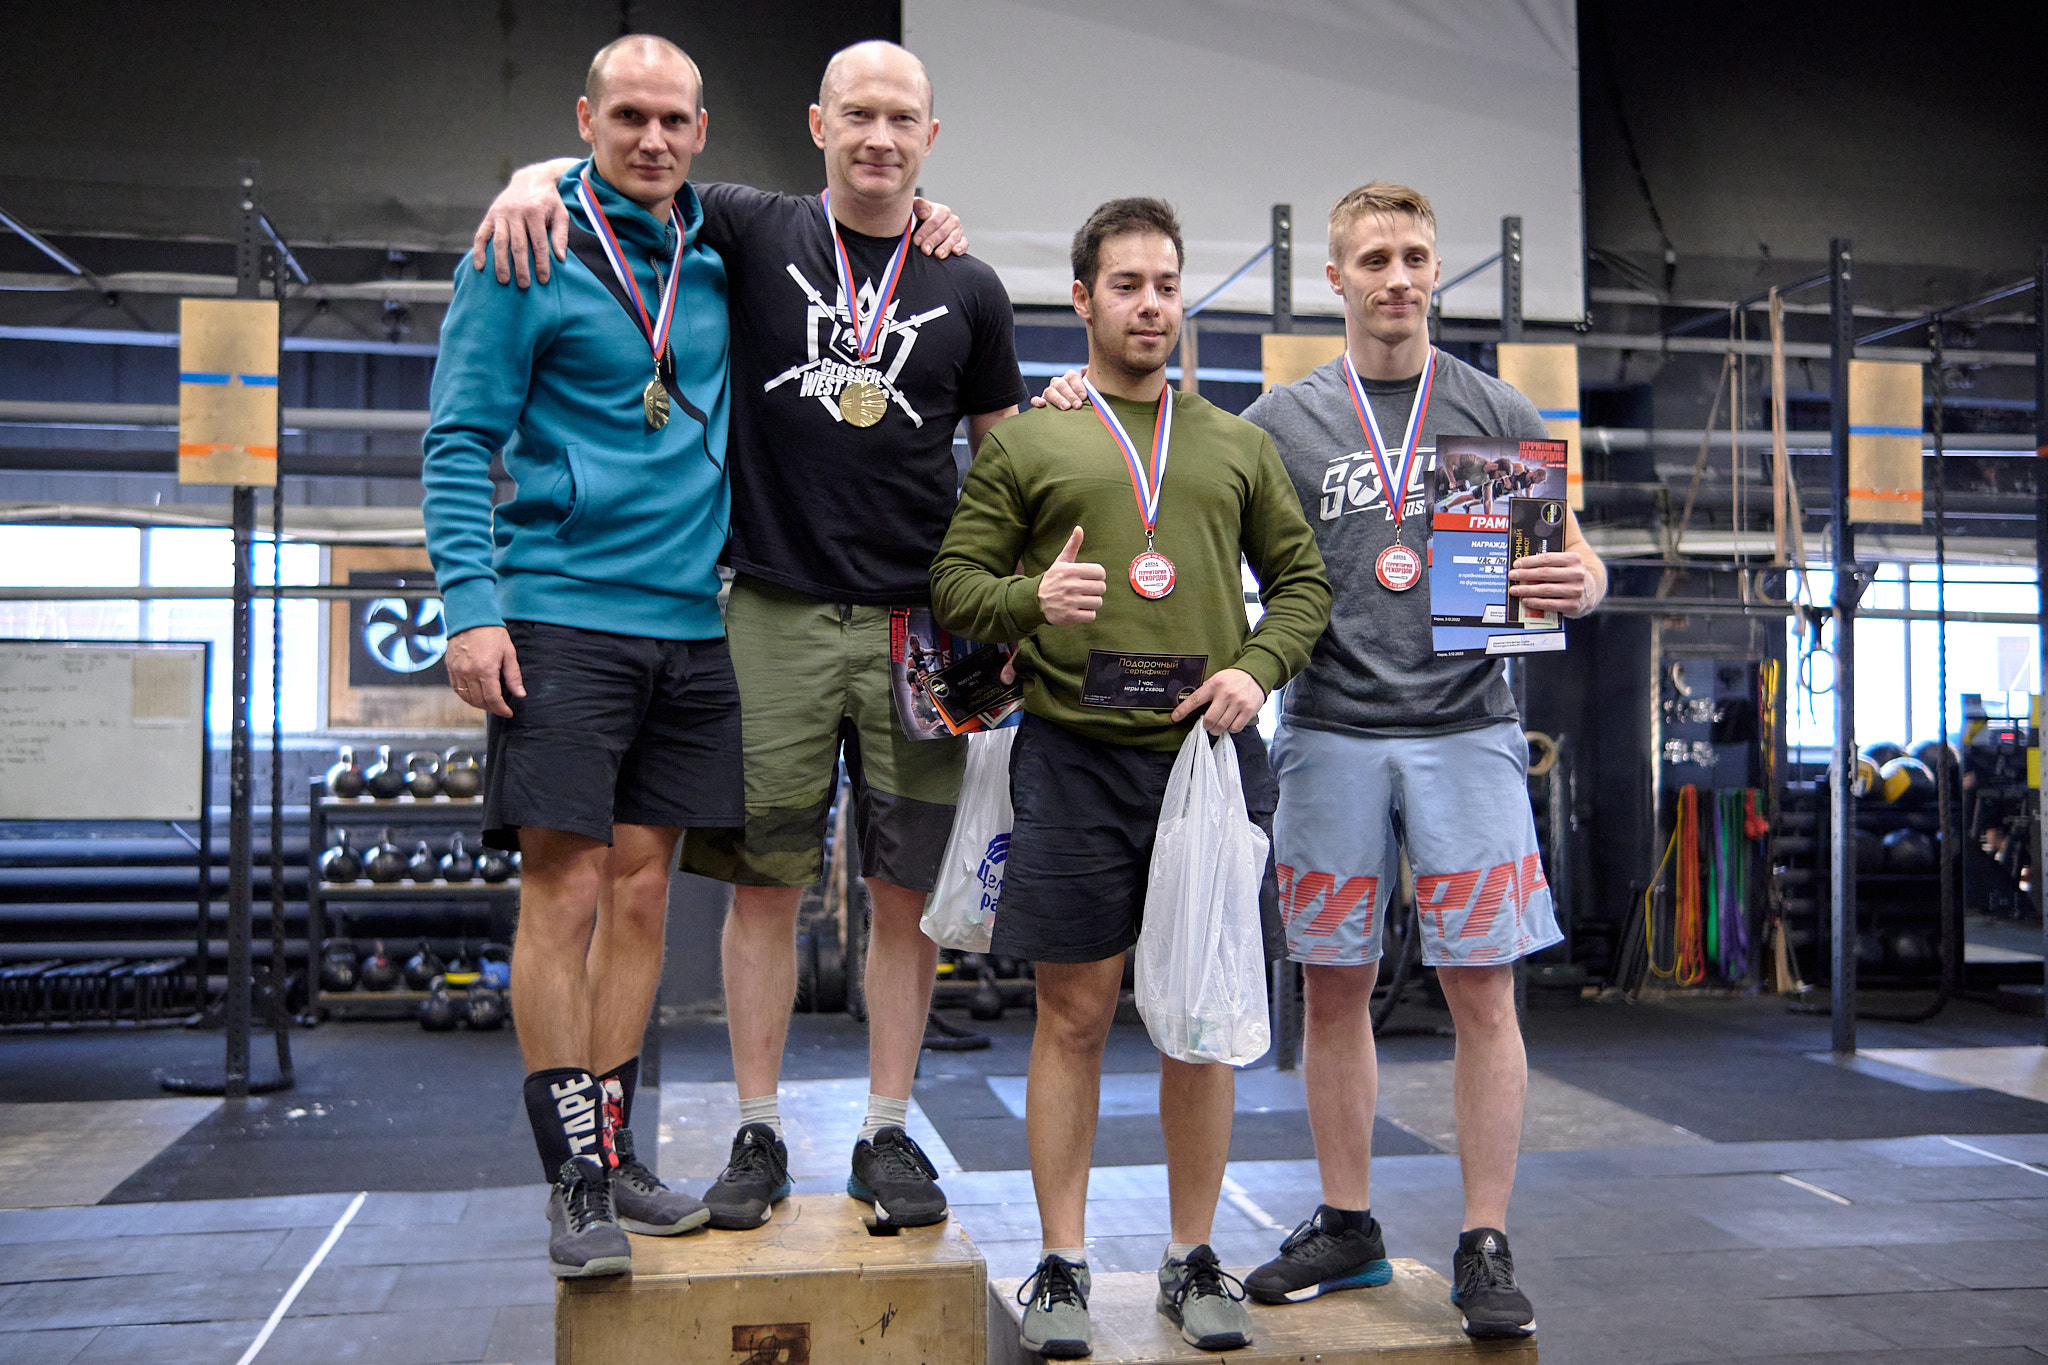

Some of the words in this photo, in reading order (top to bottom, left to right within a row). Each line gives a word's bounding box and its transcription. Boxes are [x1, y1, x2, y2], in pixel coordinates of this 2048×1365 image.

[820, 357, 883, 385] CrossFit
[800, 370, 845, 397] WEST
[1519, 441, 1565, 451] ТЕРРИТОРИЯ
[1519, 450, 1565, 462] РЕКОРДОВ
[1469, 516, 1509, 529] ГРАМ
[1119, 658, 1178, 668] Подарочный
[1124, 667, 1170, 675] сертификат
[977, 859, 1003, 890] Цел
